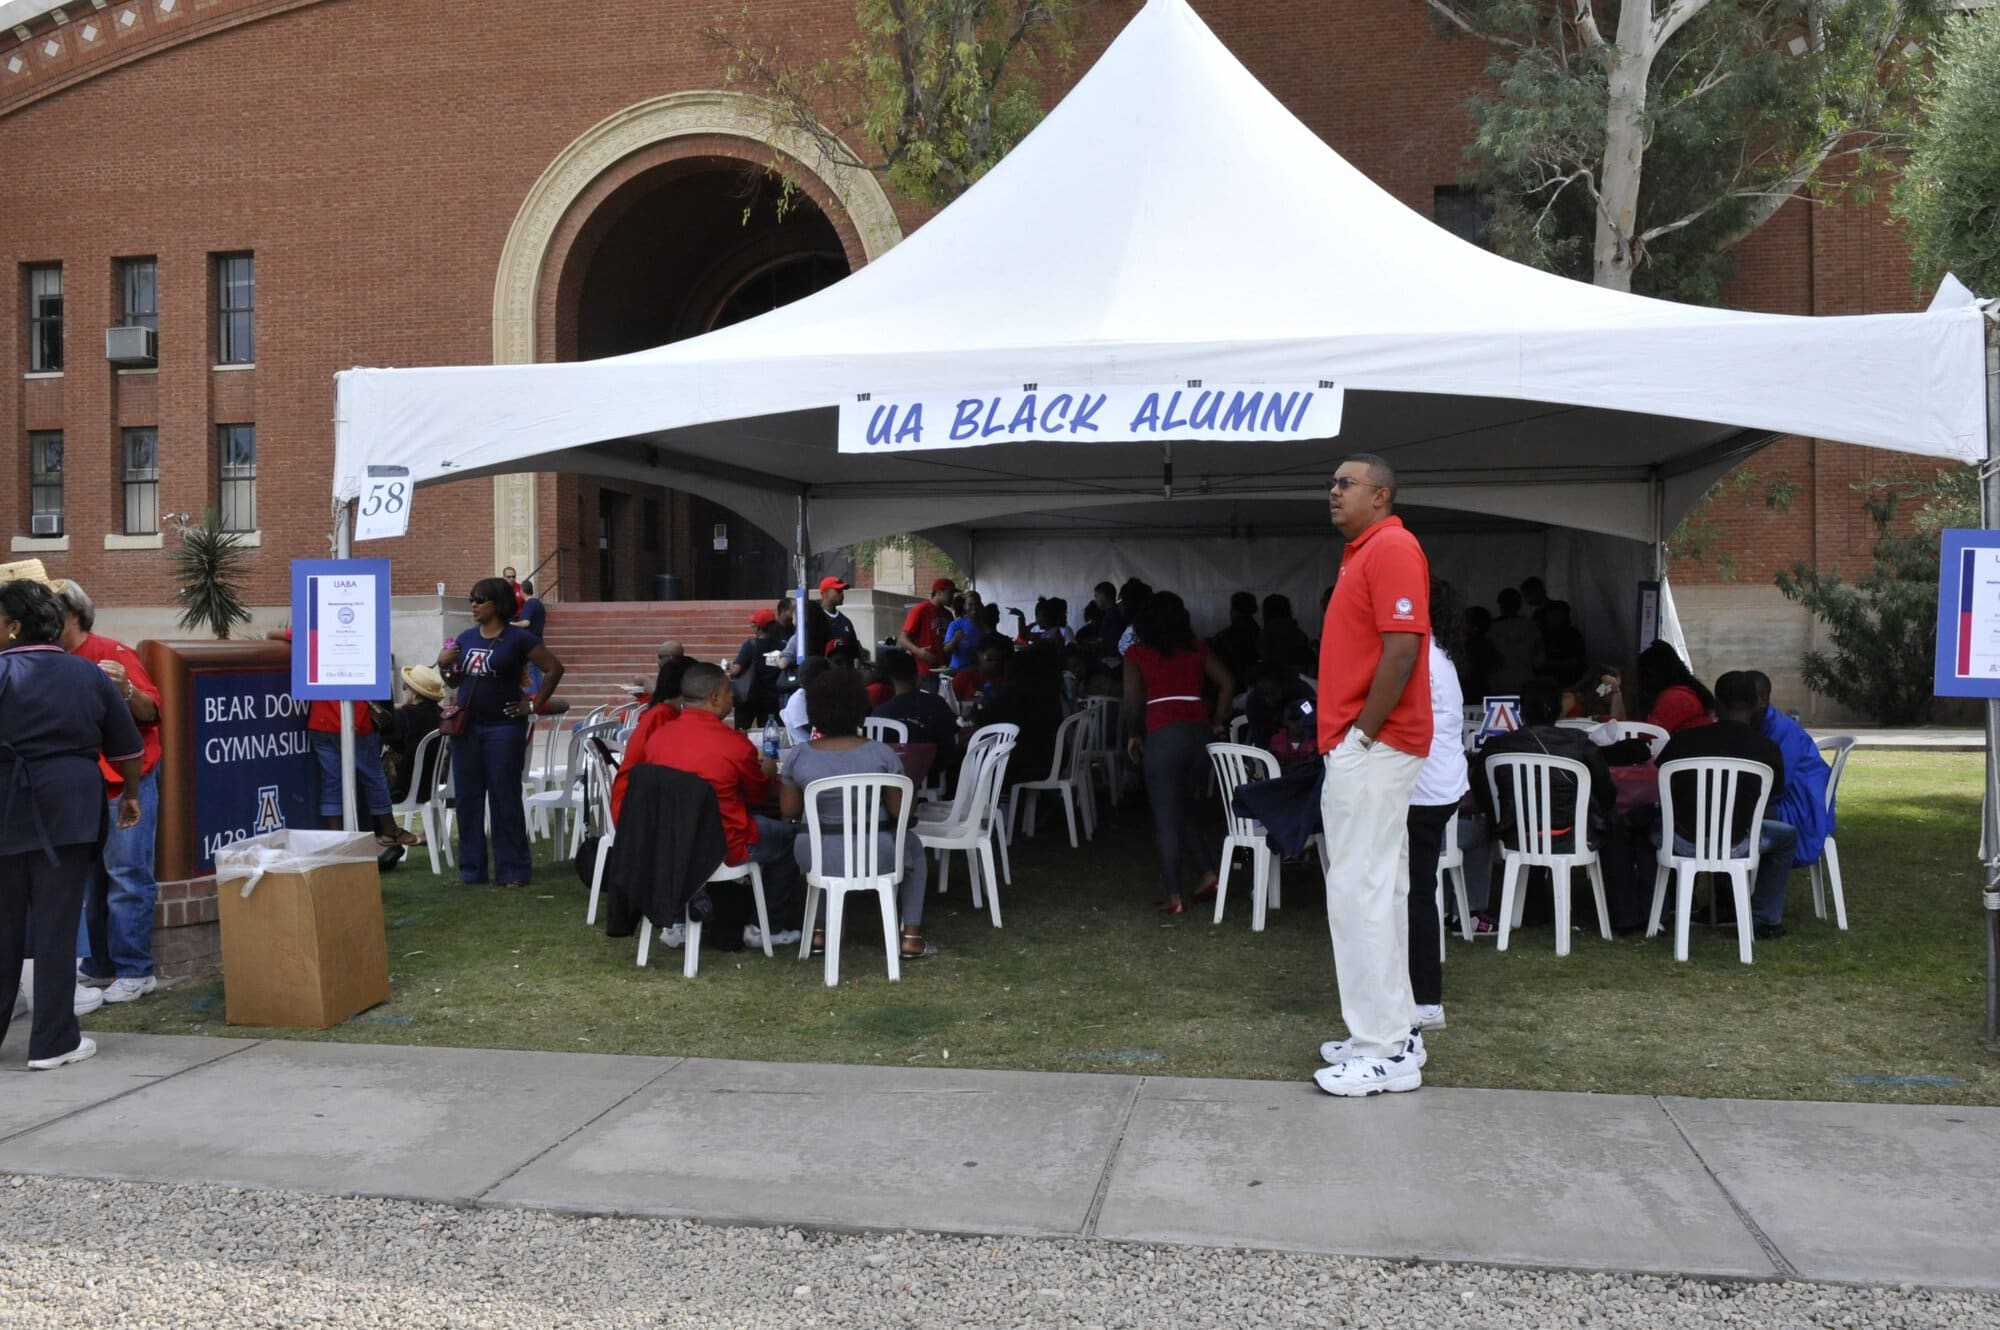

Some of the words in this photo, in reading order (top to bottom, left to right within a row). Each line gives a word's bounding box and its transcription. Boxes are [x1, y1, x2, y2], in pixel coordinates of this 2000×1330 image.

[866, 402, 924, 446] UA
[949, 393, 1107, 441] BLACK
[1130, 390, 1314, 433] ALUMNI
[362, 481, 405, 517] 58
[333, 580, 357, 589] UABA
[204, 695, 257, 723] BEAR
[204, 731, 311, 764] GYMNASIU
